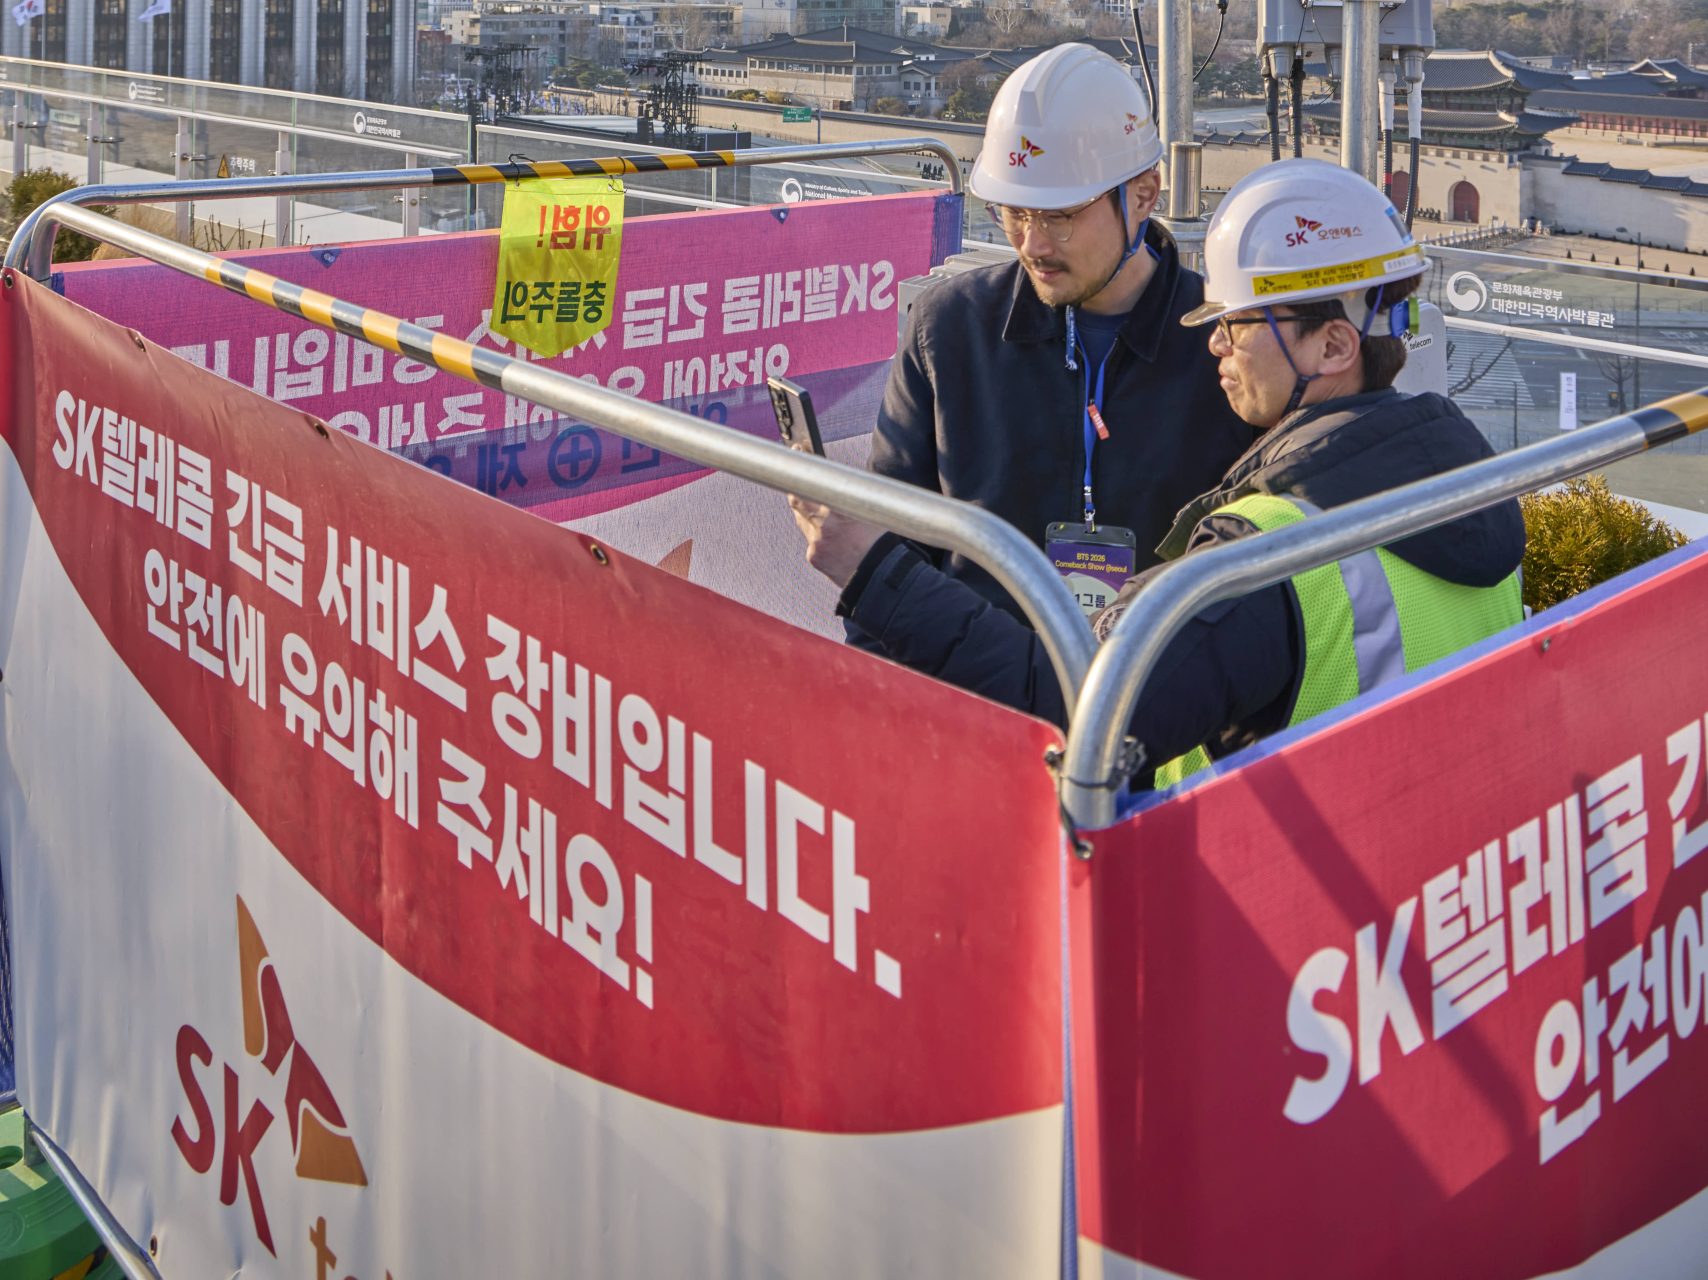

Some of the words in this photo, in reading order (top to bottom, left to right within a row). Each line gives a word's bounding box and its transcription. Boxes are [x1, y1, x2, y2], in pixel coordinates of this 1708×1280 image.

[1123, 122, 1136, 135] SK
[229, 156, 256, 173] 추락주의
[1008, 151, 1028, 168] SK
[804, 190, 826, 199] National
[1285, 230, 1310, 247] SK
[1491, 281, 1563, 301] 문화체육관광부
[1491, 299, 1616, 329] 대한민국역사박물관
[1409, 337, 1432, 351] telecom
[1076, 552, 1089, 561] BTS
[1055, 559, 1087, 570] Comeback
[1087, 563, 1105, 572] Show
[52, 390, 214, 551] SK텔레콤
[225, 468, 305, 608] 긴급
[317, 525, 467, 713] 서비스
[485, 613, 902, 1000] 장비입니다.
[143, 548, 266, 710] 안전에
[280, 632, 419, 830] 유의해
[437, 738, 654, 1010] 주세요!
[1282, 753, 1649, 1125] SK텔레콤
[170, 1024, 278, 1260] SK
